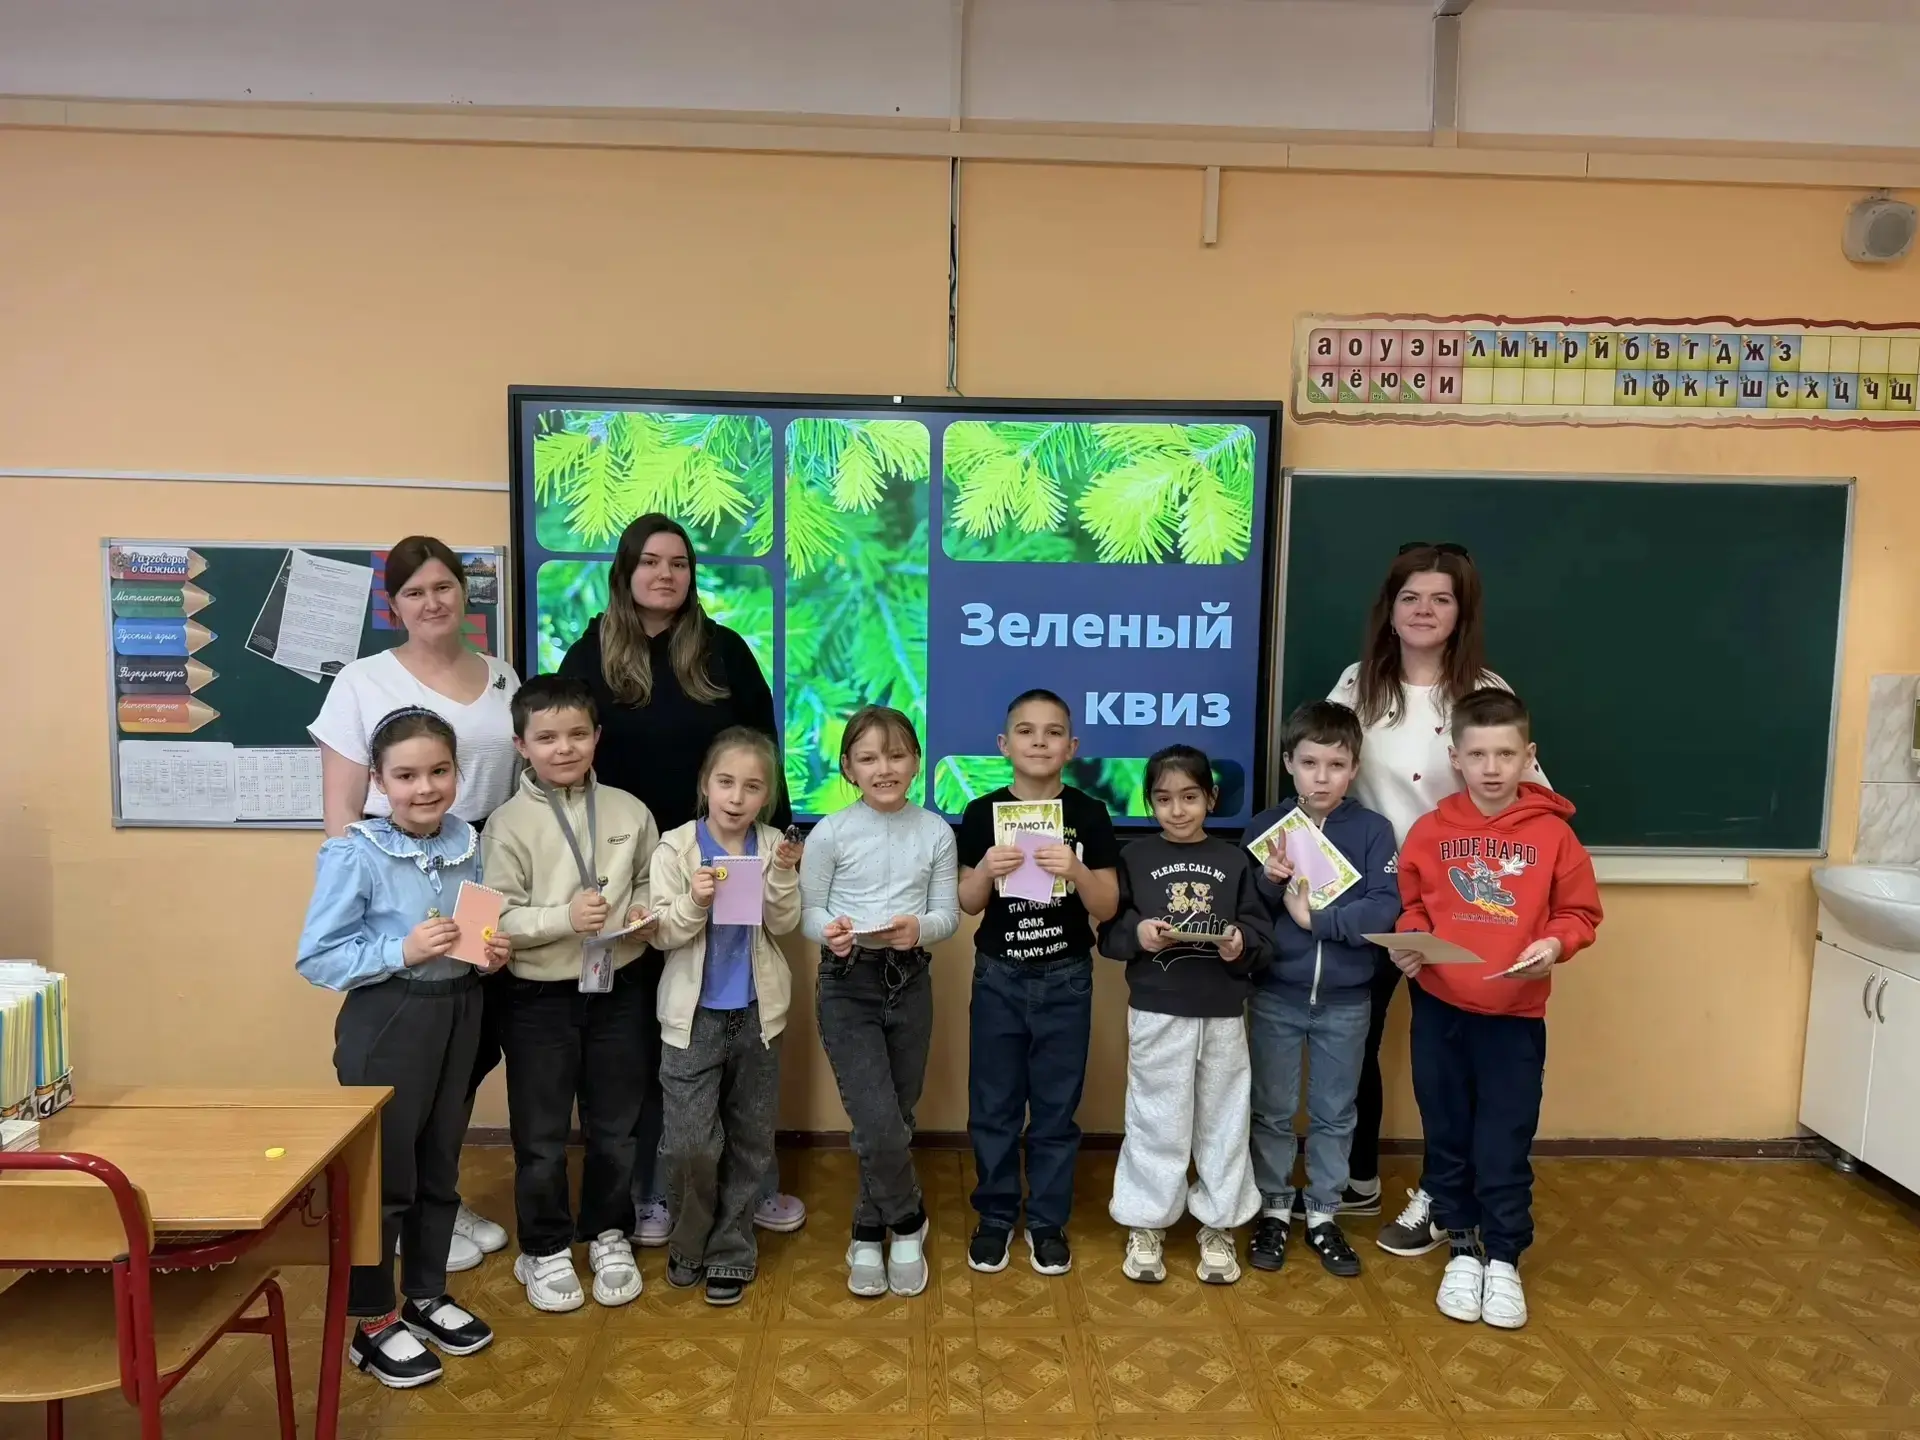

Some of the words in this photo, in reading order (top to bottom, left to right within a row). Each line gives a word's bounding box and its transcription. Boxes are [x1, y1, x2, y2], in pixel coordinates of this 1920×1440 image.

[1317, 337, 1331, 355] а
[1349, 338, 1362, 356] о
[1379, 338, 1393, 362] у
[1410, 338, 1424, 356] э
[1438, 339, 1458, 357] ы
[1471, 339, 1486, 357] л
[1501, 340, 1519, 358] м
[1533, 340, 1548, 358] н
[1563, 340, 1578, 363] р
[1594, 335, 1609, 359] й
[1625, 336, 1640, 360] б
[1656, 342, 1670, 359] в
[1688, 342, 1699, 360] г
[1716, 343, 1731, 364] д
[1744, 343, 1764, 361] ж
[1778, 343, 1792, 362] з
[1320, 372, 1334, 387] я
[1350, 369, 1362, 388] ё
[1380, 372, 1398, 388] ю
[1413, 373, 1426, 388] е
[1439, 376, 1454, 393] и
[1623, 377, 1637, 396] п
[1652, 374, 1669, 401] ф
[1684, 379, 1698, 397] к
[1715, 379, 1729, 397] т
[1742, 380, 1762, 398] ш
[1775, 380, 1789, 398] с
[1805, 381, 1820, 399] х
[1835, 382, 1849, 403] ц
[1866, 382, 1879, 400] ч
[1891, 382, 1912, 404] щ
[131, 552, 186, 565] Разговоры
[140, 563, 186, 574] важном
[113, 591, 182, 602] Математика
[960, 601, 1233, 649] Зеленый
[117, 628, 153, 643] Русский
[154, 633, 178, 643] язык
[118, 666, 185, 682] Физкультура
[1085, 691, 1231, 727] квиз
[1004, 821, 1055, 831] ГРАМОТА
[1439, 836, 1481, 861] RIDE
[1484, 836, 1537, 866] HARD
[1188, 863, 1213, 876] CALL
[1213, 868, 1226, 883] ME
[1008, 901, 1026, 913] STAY
[1018, 917, 1044, 929] GENIUS
[1005, 931, 1015, 942] OF
[1016, 925, 1063, 941] IMAGINATION
[1006, 948, 1022, 958] FUN
[1023, 946, 1044, 958] DAYS
[1045, 941, 1068, 955] AHEAD
